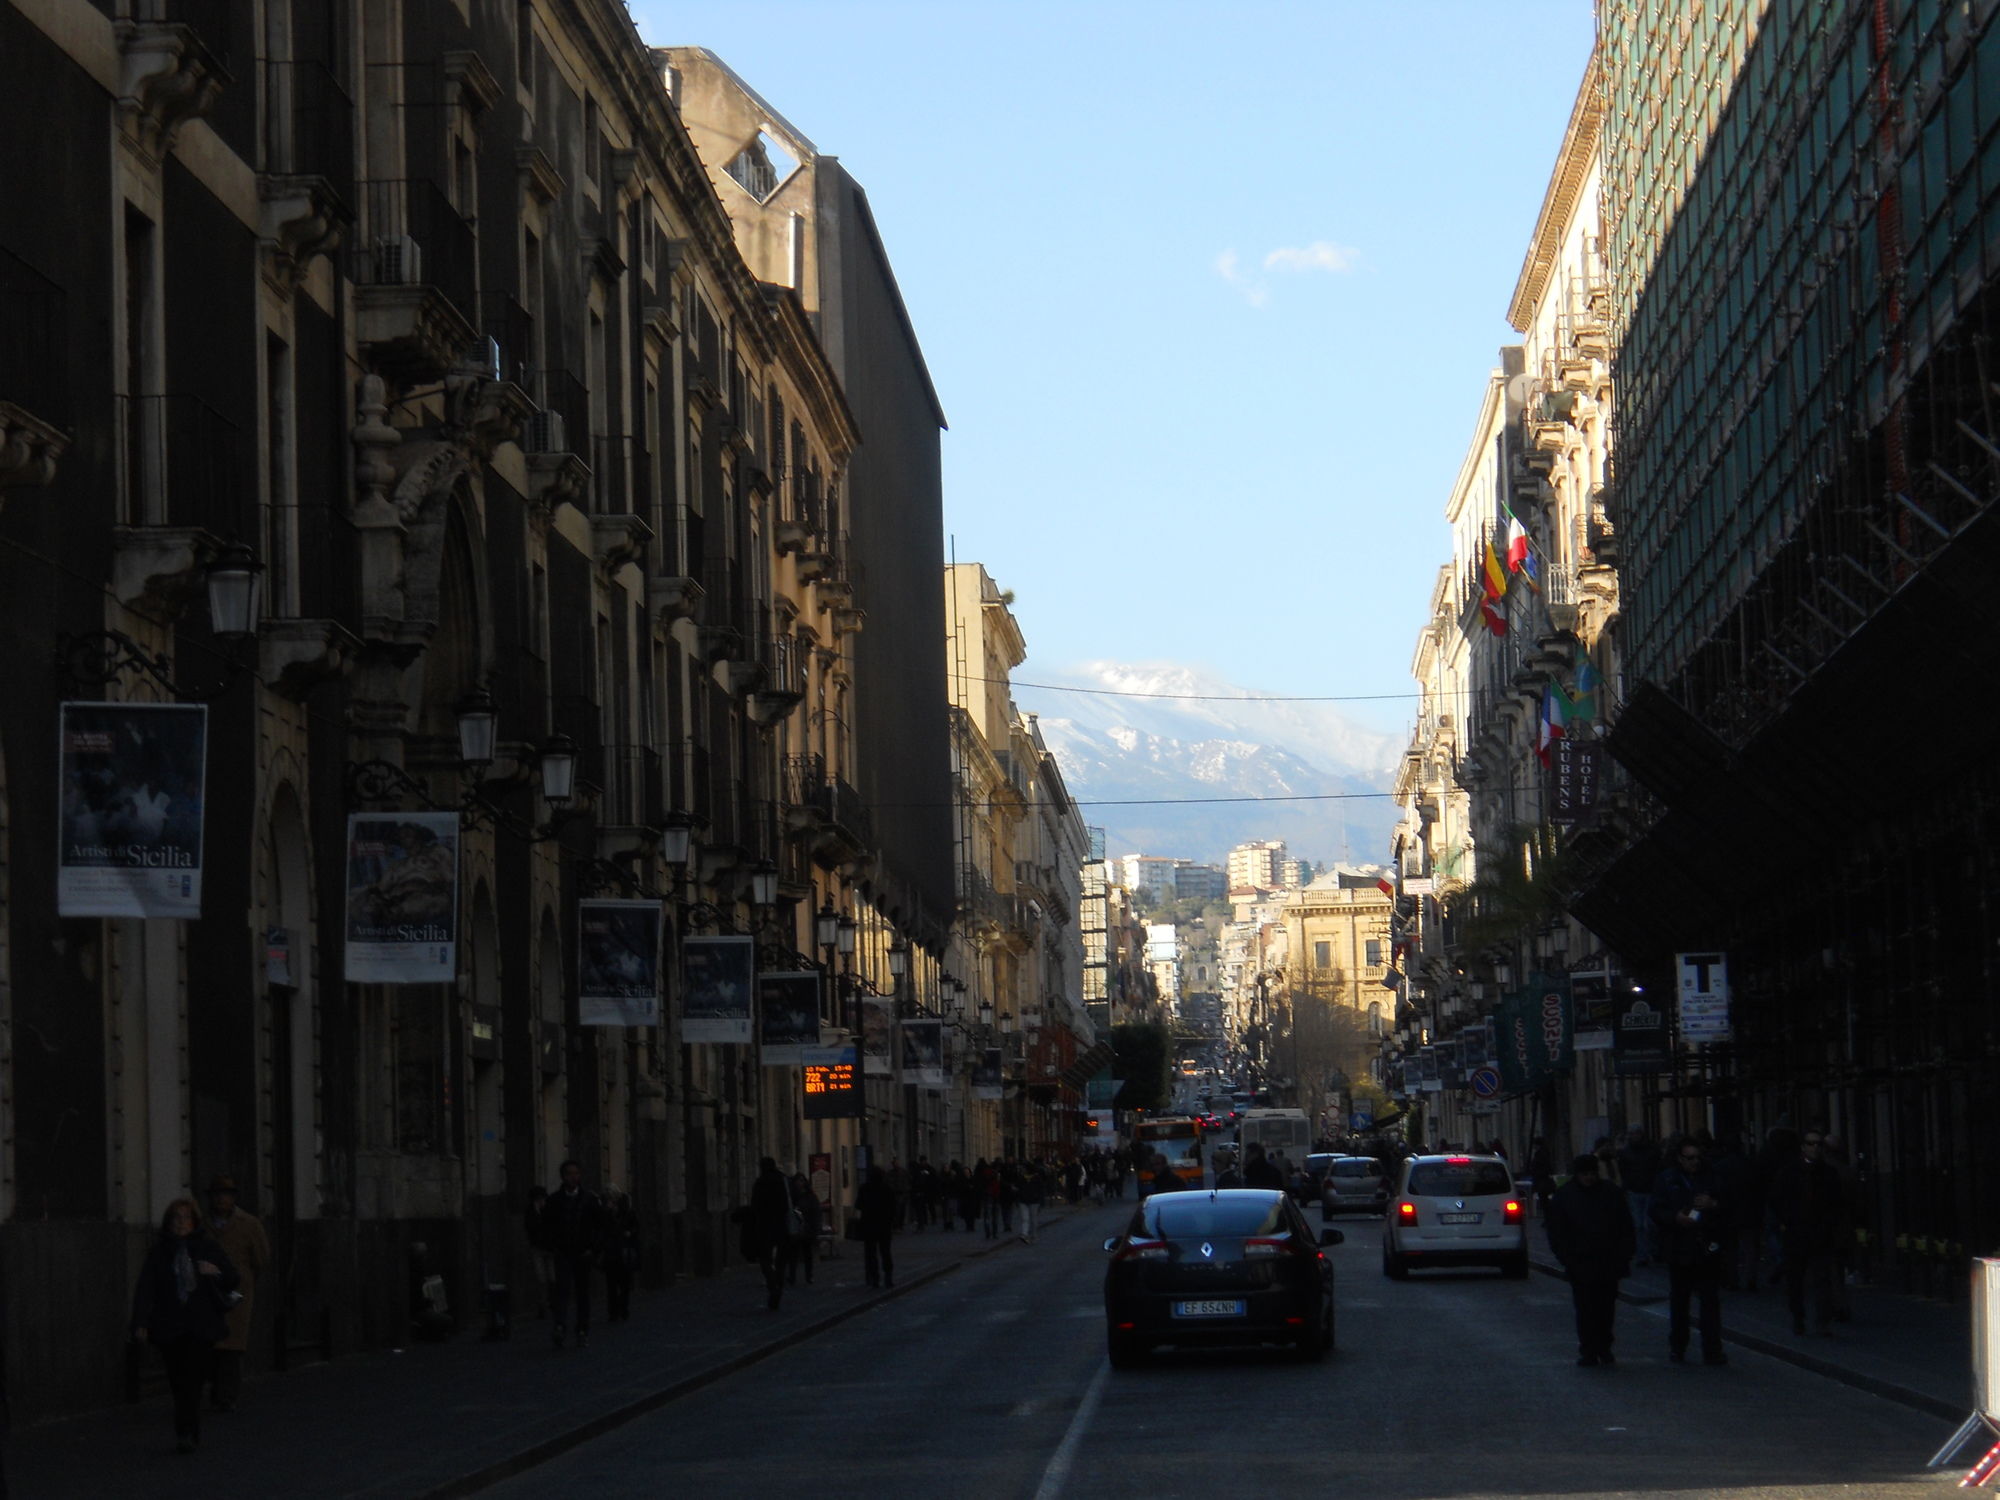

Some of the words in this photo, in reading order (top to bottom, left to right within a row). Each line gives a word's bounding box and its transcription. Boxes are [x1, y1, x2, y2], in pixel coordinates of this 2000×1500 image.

[1560, 741, 1571, 808] RUBENS
[1580, 755, 1592, 805] HOTEL
[70, 844, 113, 857] Artisti
[127, 842, 193, 867] Sicilia
[387, 924, 397, 936] di
[397, 923, 449, 942] Sicilia
[1684, 955, 1720, 993] T
[1542, 993, 1564, 1061] SCONTI
[805, 1072, 821, 1082] 722
